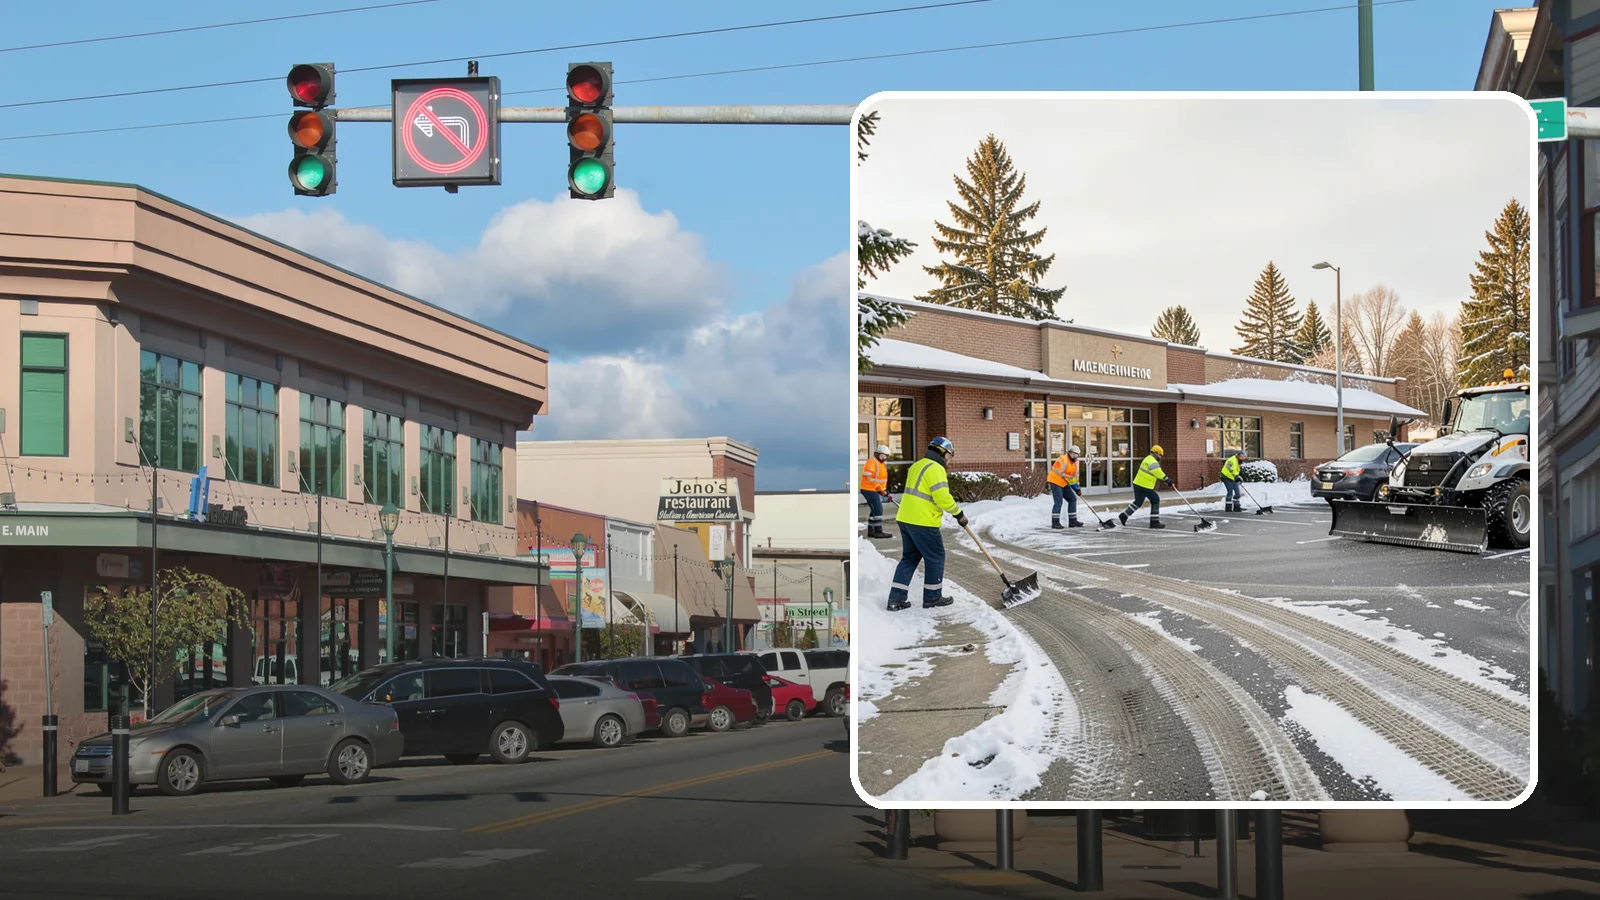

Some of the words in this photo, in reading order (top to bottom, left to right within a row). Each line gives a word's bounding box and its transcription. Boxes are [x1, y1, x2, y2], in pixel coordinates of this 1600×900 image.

[669, 480, 727, 494] Jeno's
[665, 496, 731, 509] restaurant
[659, 510, 681, 519] Italian
[686, 510, 714, 519] American
[715, 510, 737, 519] Cuisine
[2, 525, 13, 536] E.
[15, 525, 49, 536] MAIN
[797, 607, 828, 617] Street
